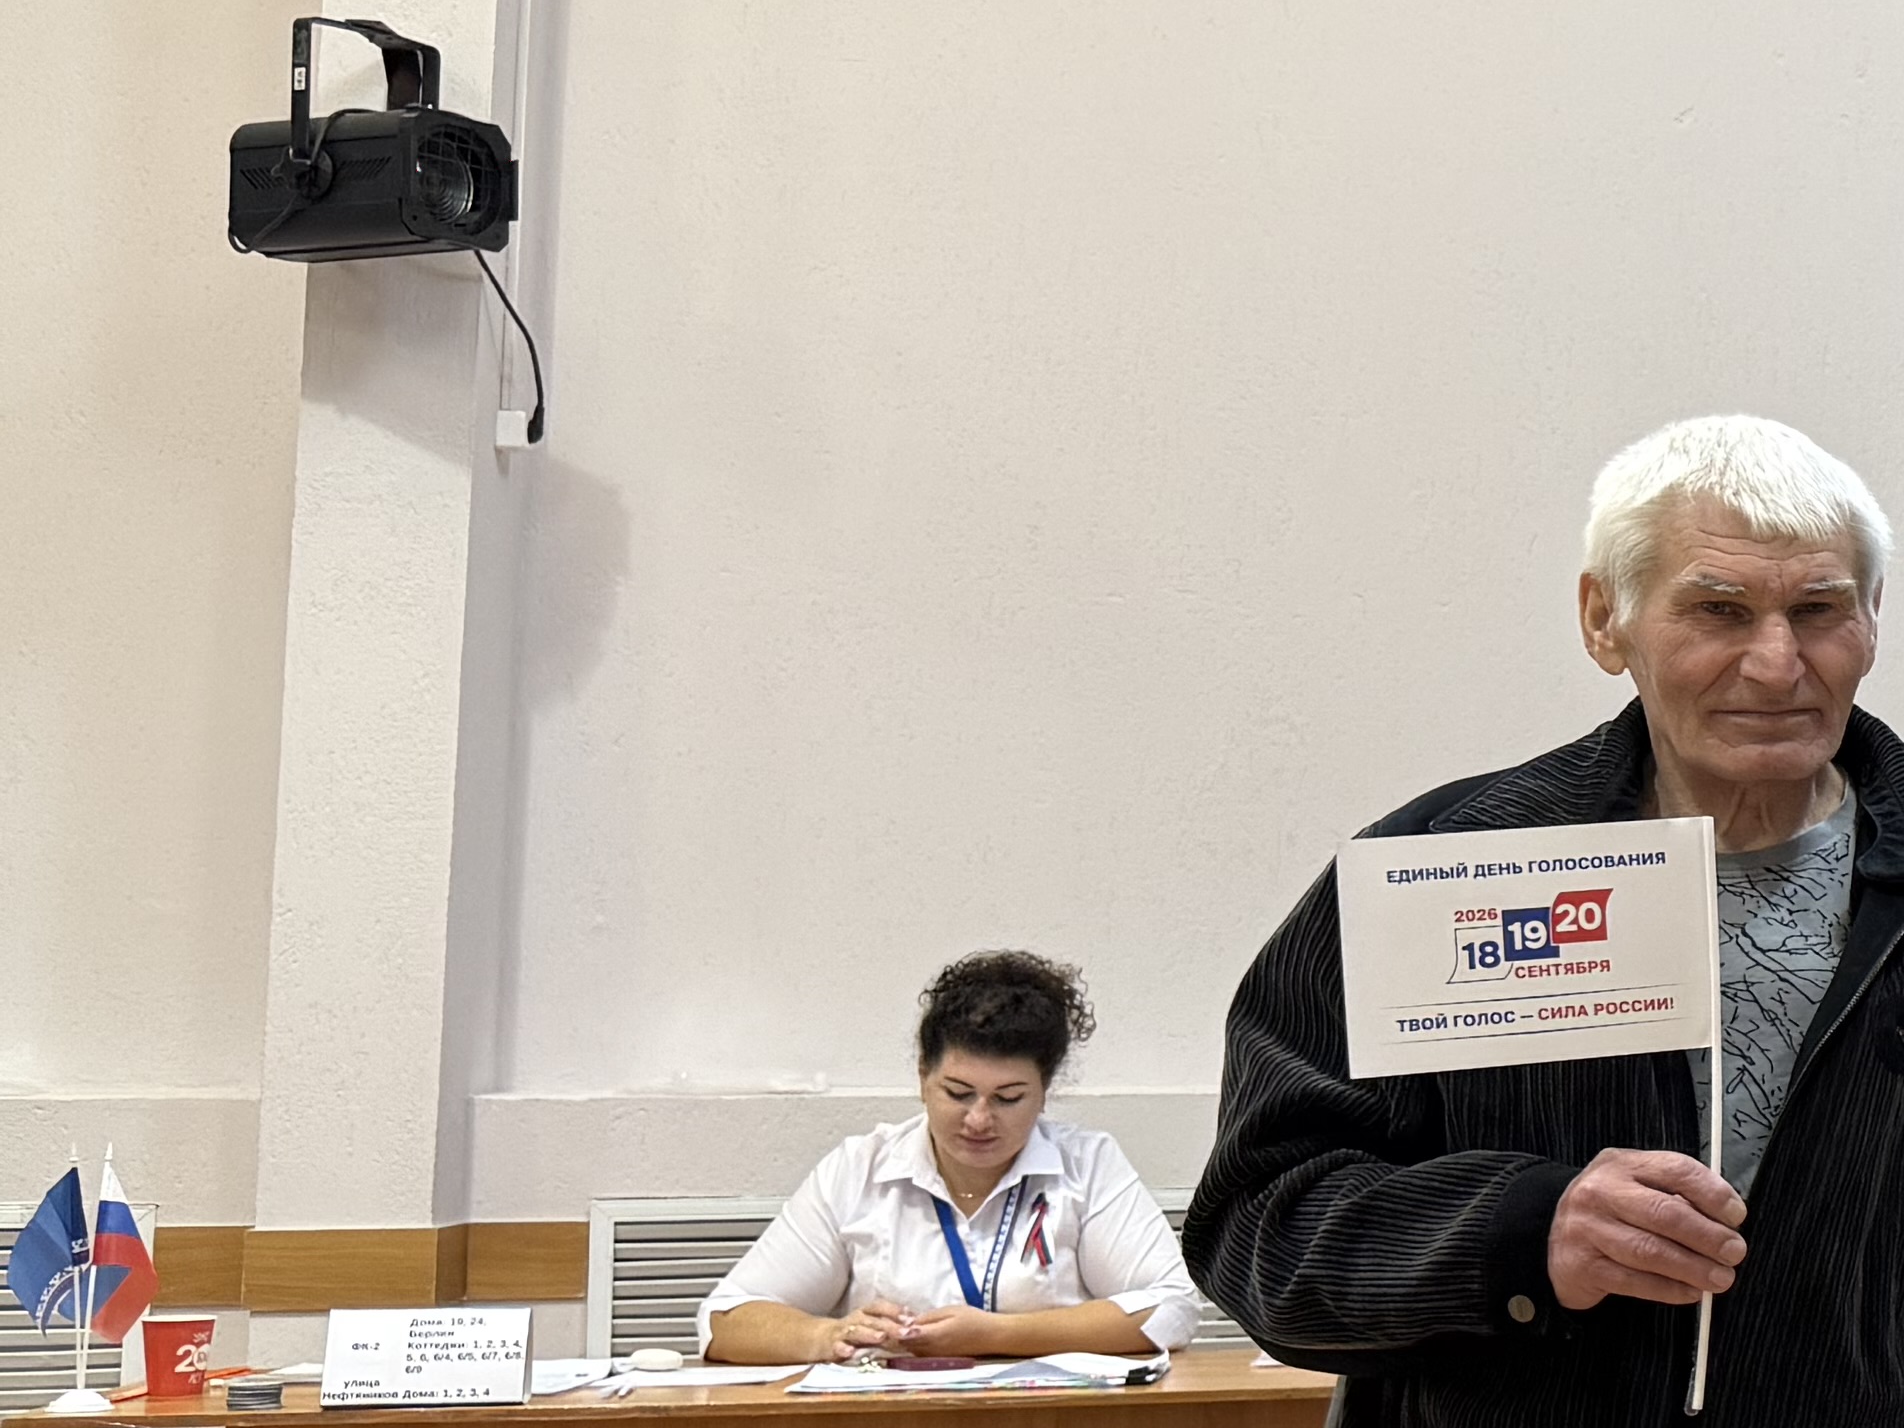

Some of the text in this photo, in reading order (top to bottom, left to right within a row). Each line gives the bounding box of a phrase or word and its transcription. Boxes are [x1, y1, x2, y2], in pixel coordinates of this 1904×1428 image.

[1387, 852, 1666, 884] ЕДИНЫЙ ДЕНЬ ГОЛОСОВАНИЯ
[1454, 908, 1498, 923] 2026
[1462, 902, 1602, 970] 18 19 20
[1515, 959, 1611, 979] СЕНТЯБРЯ
[1396, 1013, 1448, 1033] ТВОЙ
[1453, 1011, 1515, 1027] ГОЛОС
[1538, 1004, 1588, 1021] СИЛА
[1594, 997, 1674, 1017] РОССИИ!
[344, 1380, 380, 1389] улица
[402, 1389, 439, 1399] Дома:
